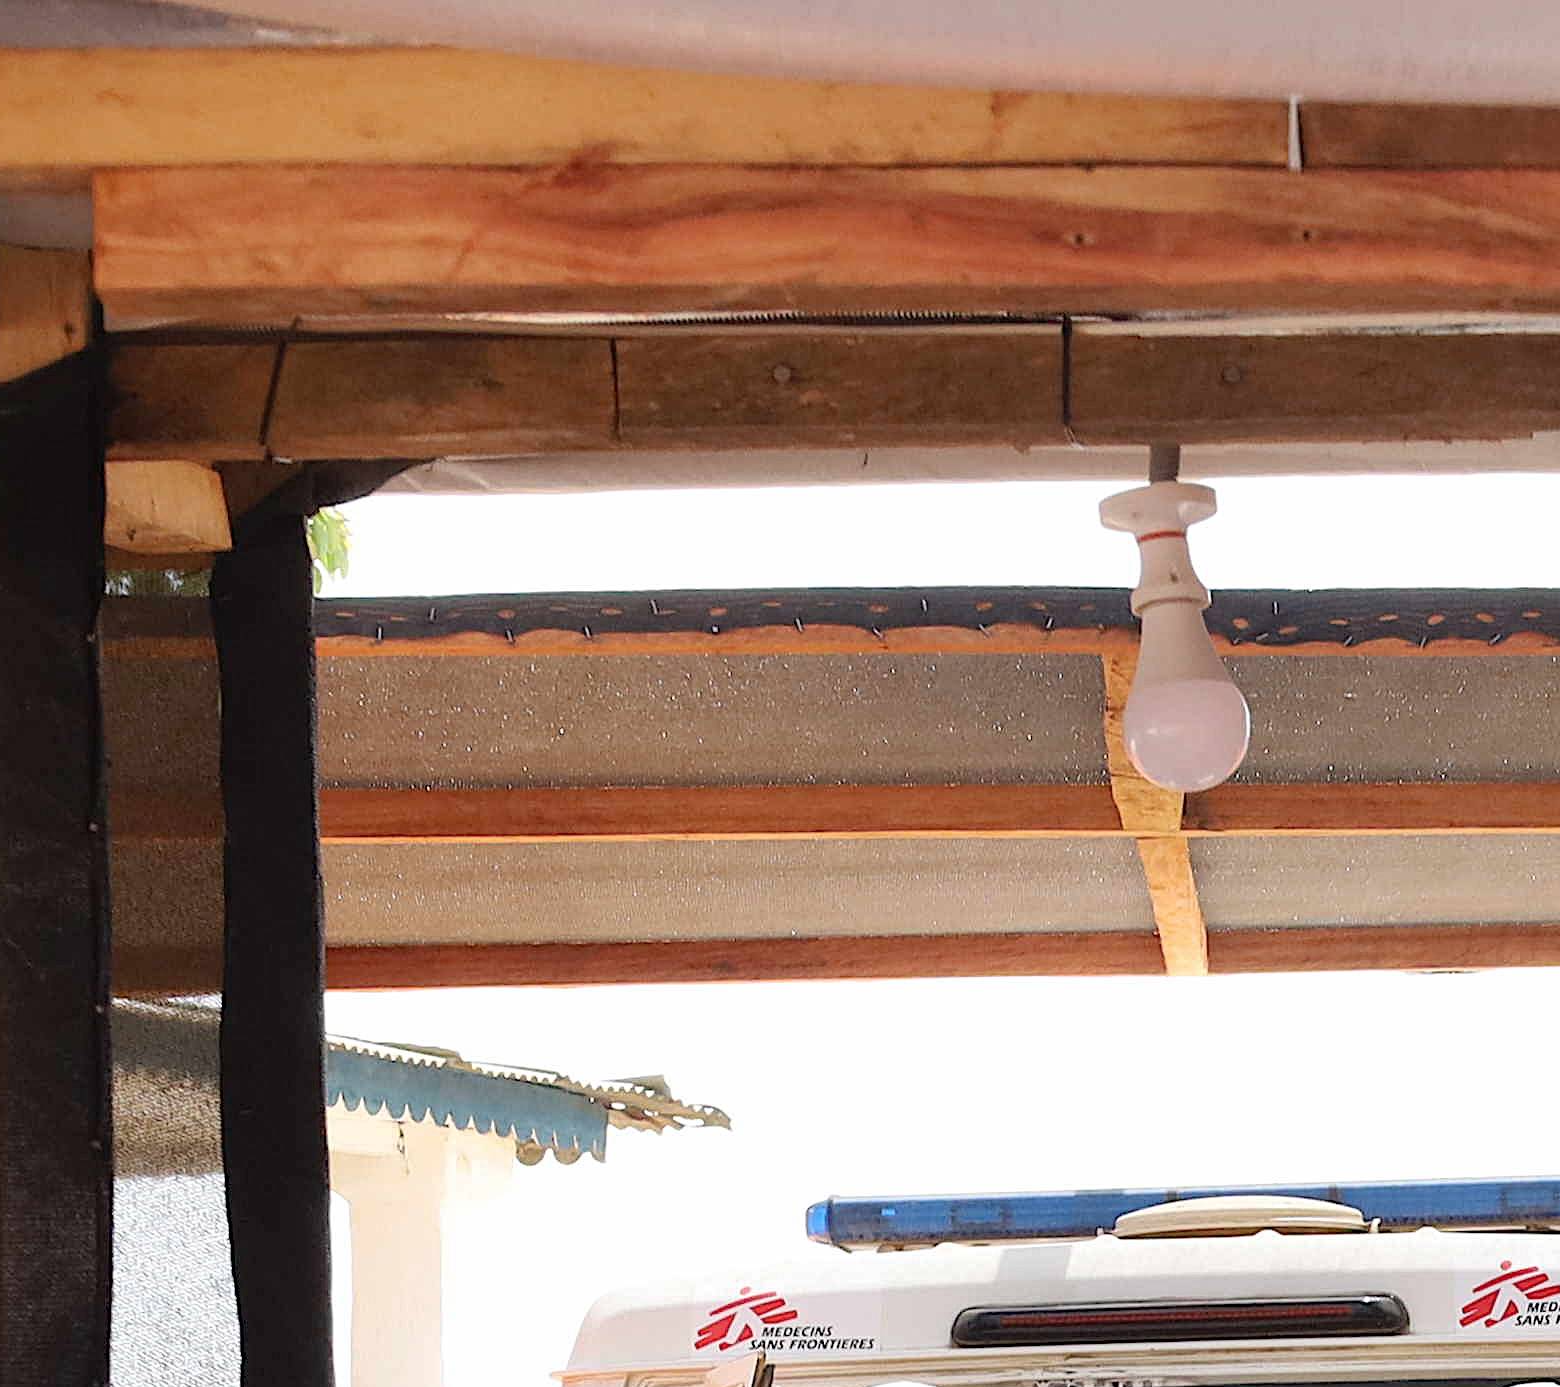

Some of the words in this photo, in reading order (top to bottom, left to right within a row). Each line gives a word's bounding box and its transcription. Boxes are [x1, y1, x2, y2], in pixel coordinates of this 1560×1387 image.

[1515, 1315, 1550, 1326] SANS
[762, 1326, 833, 1337] MEDECINS
[749, 1339, 784, 1350] SANS
[790, 1338, 875, 1350] FRONTIERES
